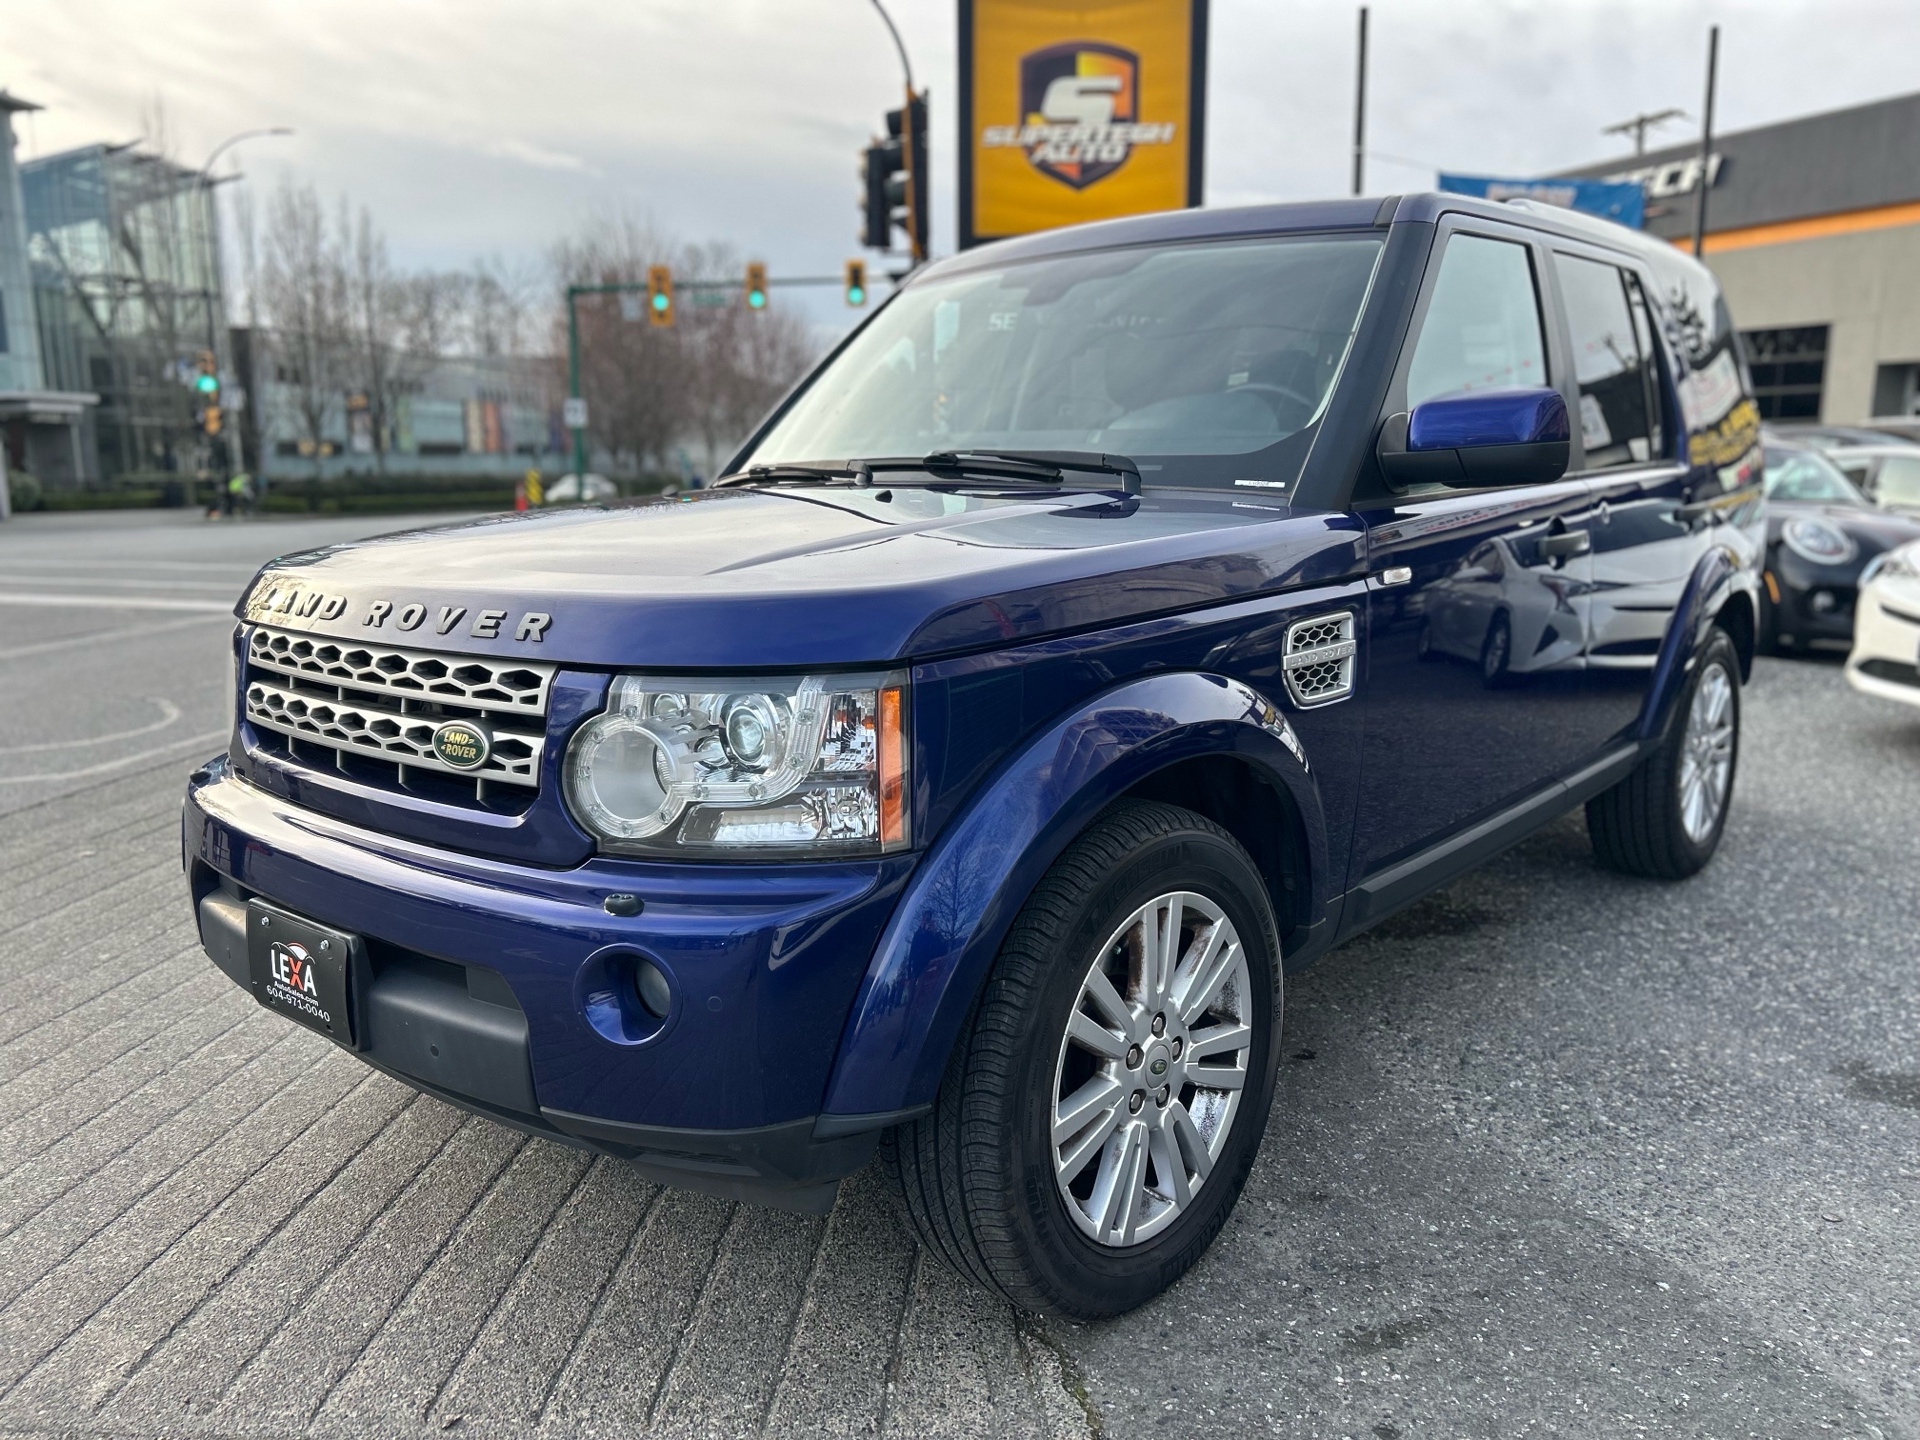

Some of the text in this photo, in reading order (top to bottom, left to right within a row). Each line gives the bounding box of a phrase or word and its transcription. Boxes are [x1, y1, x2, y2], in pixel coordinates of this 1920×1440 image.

[258, 587, 553, 643] LAND ROVER
[1290, 644, 1353, 667] LAND ROVER
[443, 731, 470, 745] LAND
[445, 743, 477, 759] ROVER
[1086, 843, 1182, 931] MICHELIN
[270, 948, 318, 997] LEXA
[266, 984, 331, 1022] 604-971-0040
